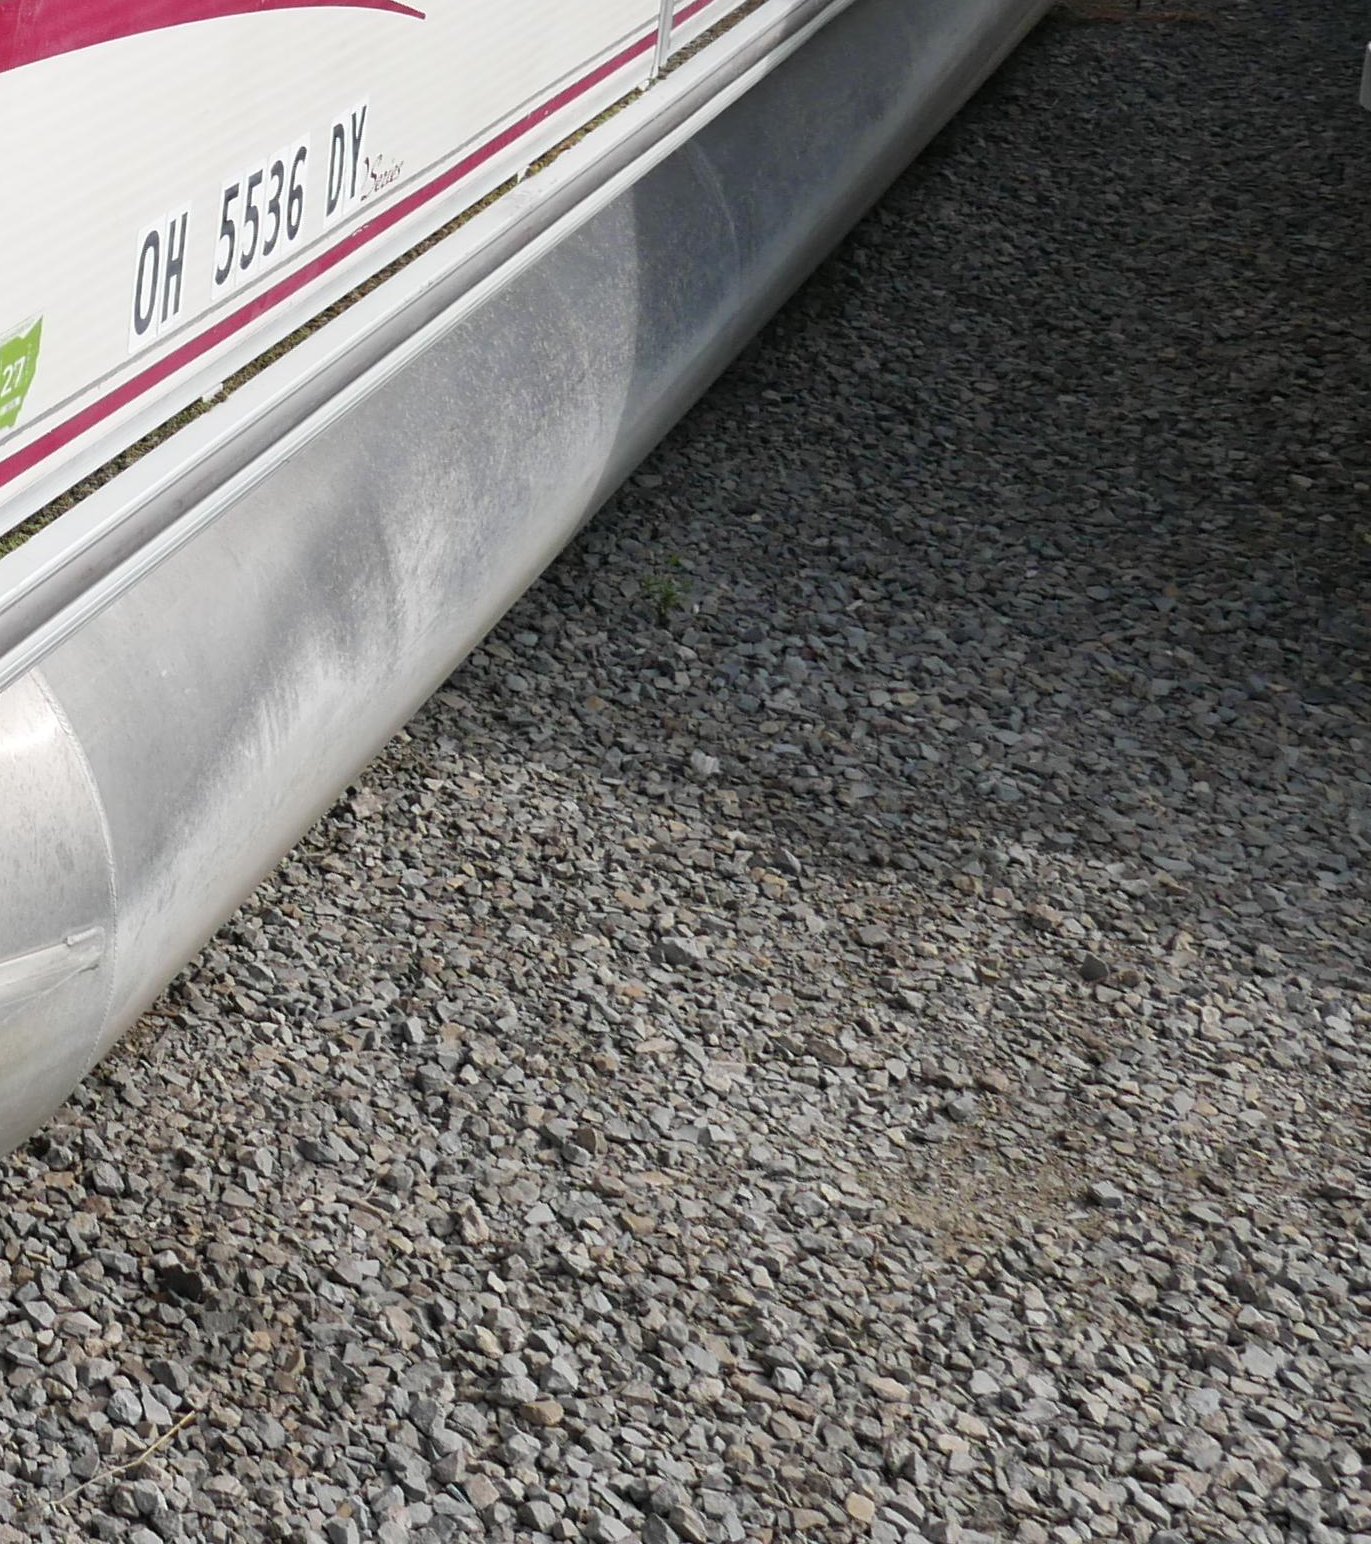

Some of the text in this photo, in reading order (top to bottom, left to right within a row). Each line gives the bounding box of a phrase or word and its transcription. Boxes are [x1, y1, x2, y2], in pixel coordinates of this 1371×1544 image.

[134, 104, 367, 336] OH 5536 DY
[0, 355, 26, 397] 27
